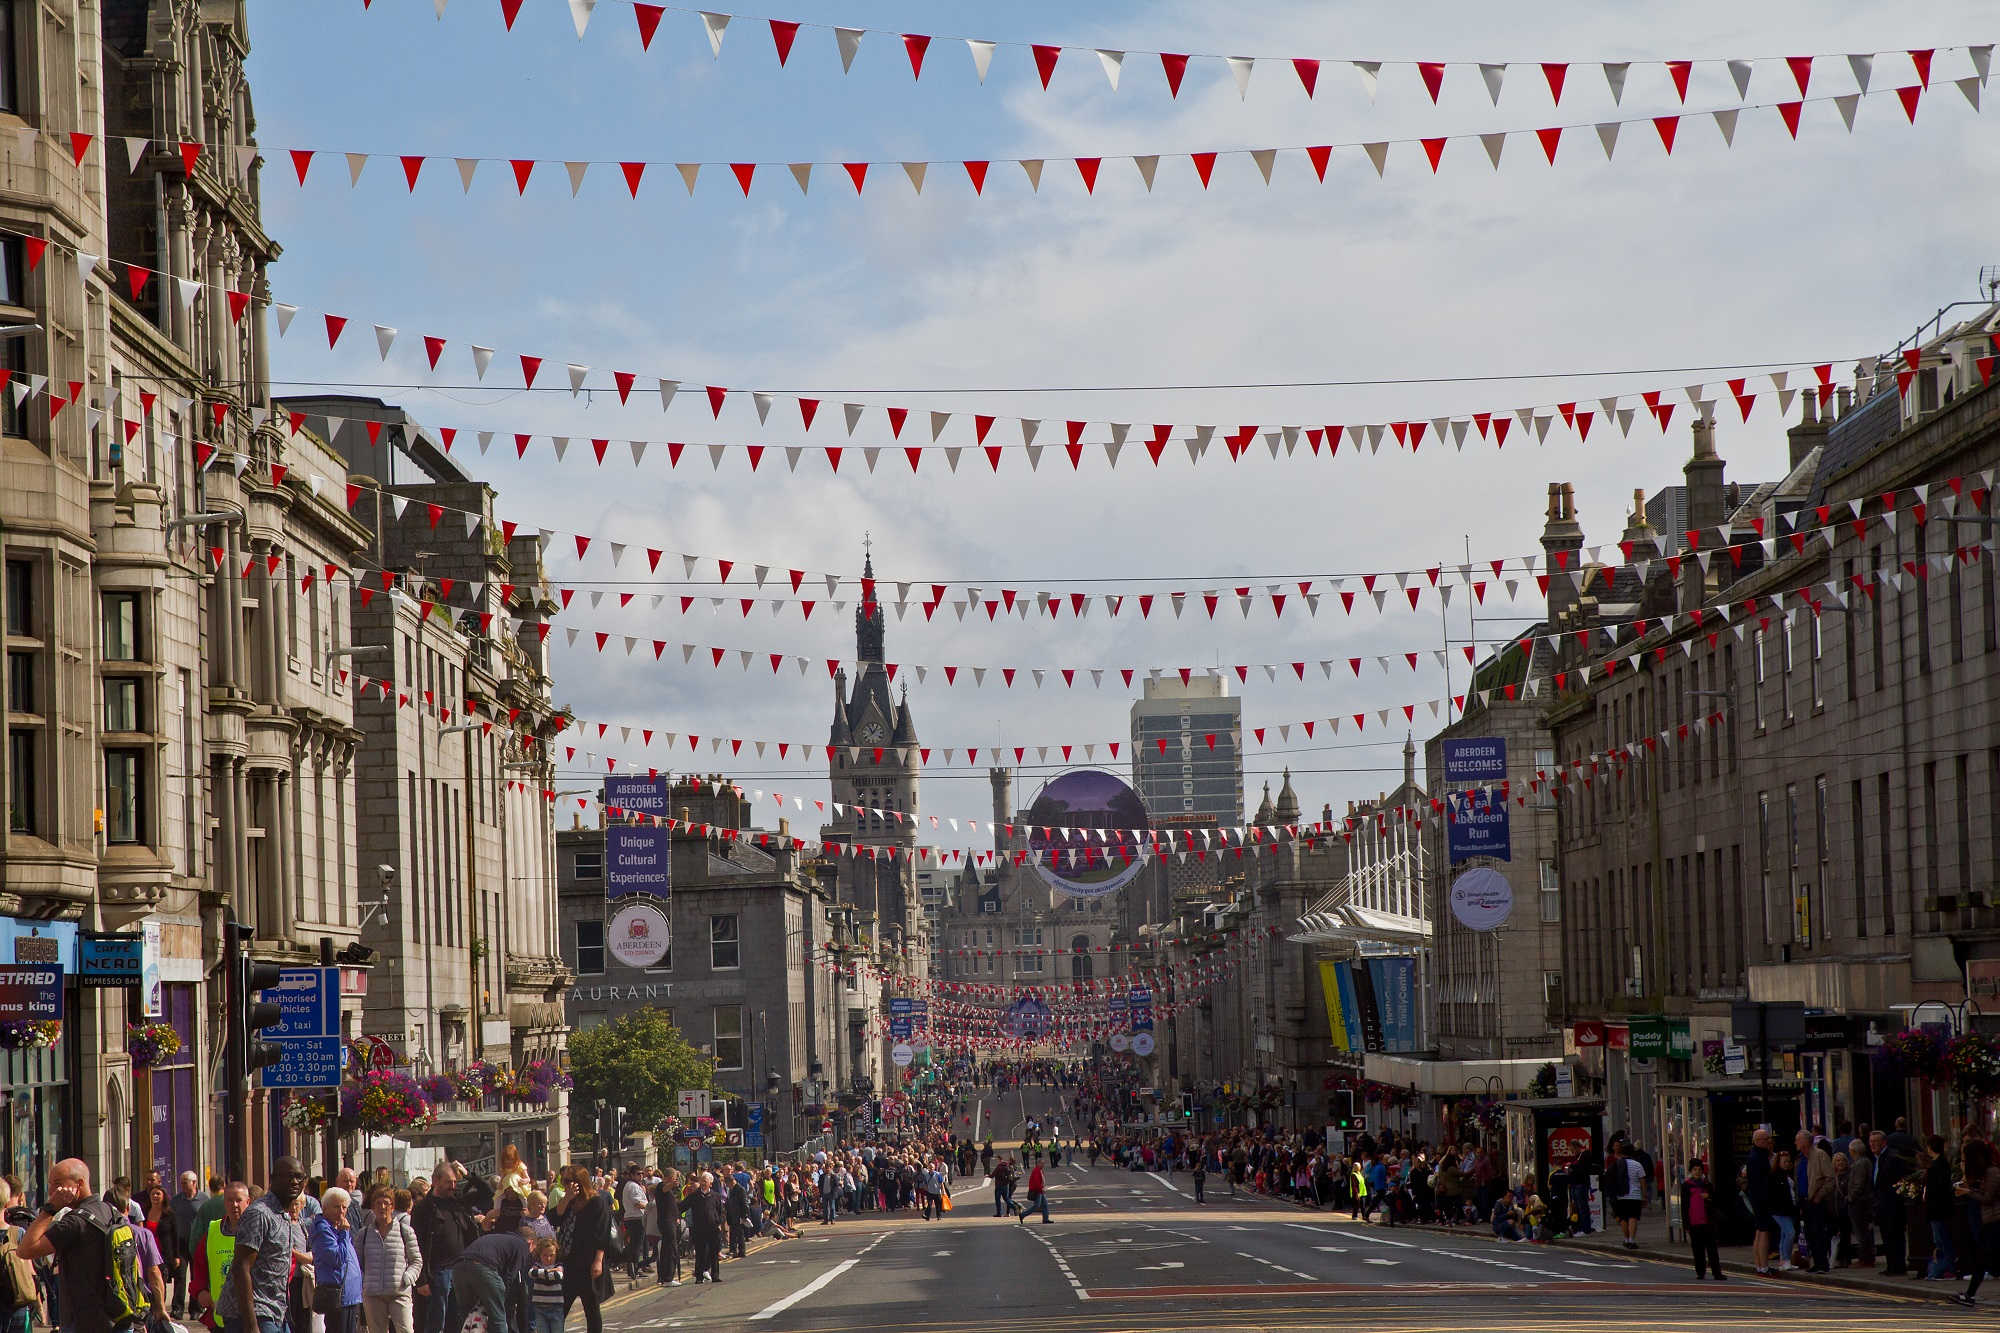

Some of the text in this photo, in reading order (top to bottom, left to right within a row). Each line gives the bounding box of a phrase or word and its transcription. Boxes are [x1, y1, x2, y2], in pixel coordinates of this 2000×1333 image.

[1455, 747, 1496, 757] ABERDEEN
[1448, 759, 1503, 772] WELCOMES
[617, 784, 657, 794] ABERDEEN
[610, 797, 664, 808] WELCOMES
[1454, 813, 1503, 824] Aberdeen
[1469, 827, 1489, 839] Run
[620, 836, 655, 850] Unique
[618, 854, 657, 865] Cultural
[610, 872, 665, 886] Experiences
[616, 941, 662, 950] ABERDEEN
[86, 958, 139, 969] NERO
[40, 990, 56, 1000] the
[267, 994, 317, 1003] authorised
[28, 1001, 56, 1013] king
[294, 1021, 311, 1030] taxi
[1632, 1031, 1663, 1043] Paddy
[306, 1041, 323, 1049] Sat
[1632, 1040, 1663, 1048] Power
[321, 1065, 336, 1073] pm
[305, 1074, 311, 1082] 6
[312, 1075, 327, 1083] pm
[228, 1114, 235, 1124] 2
